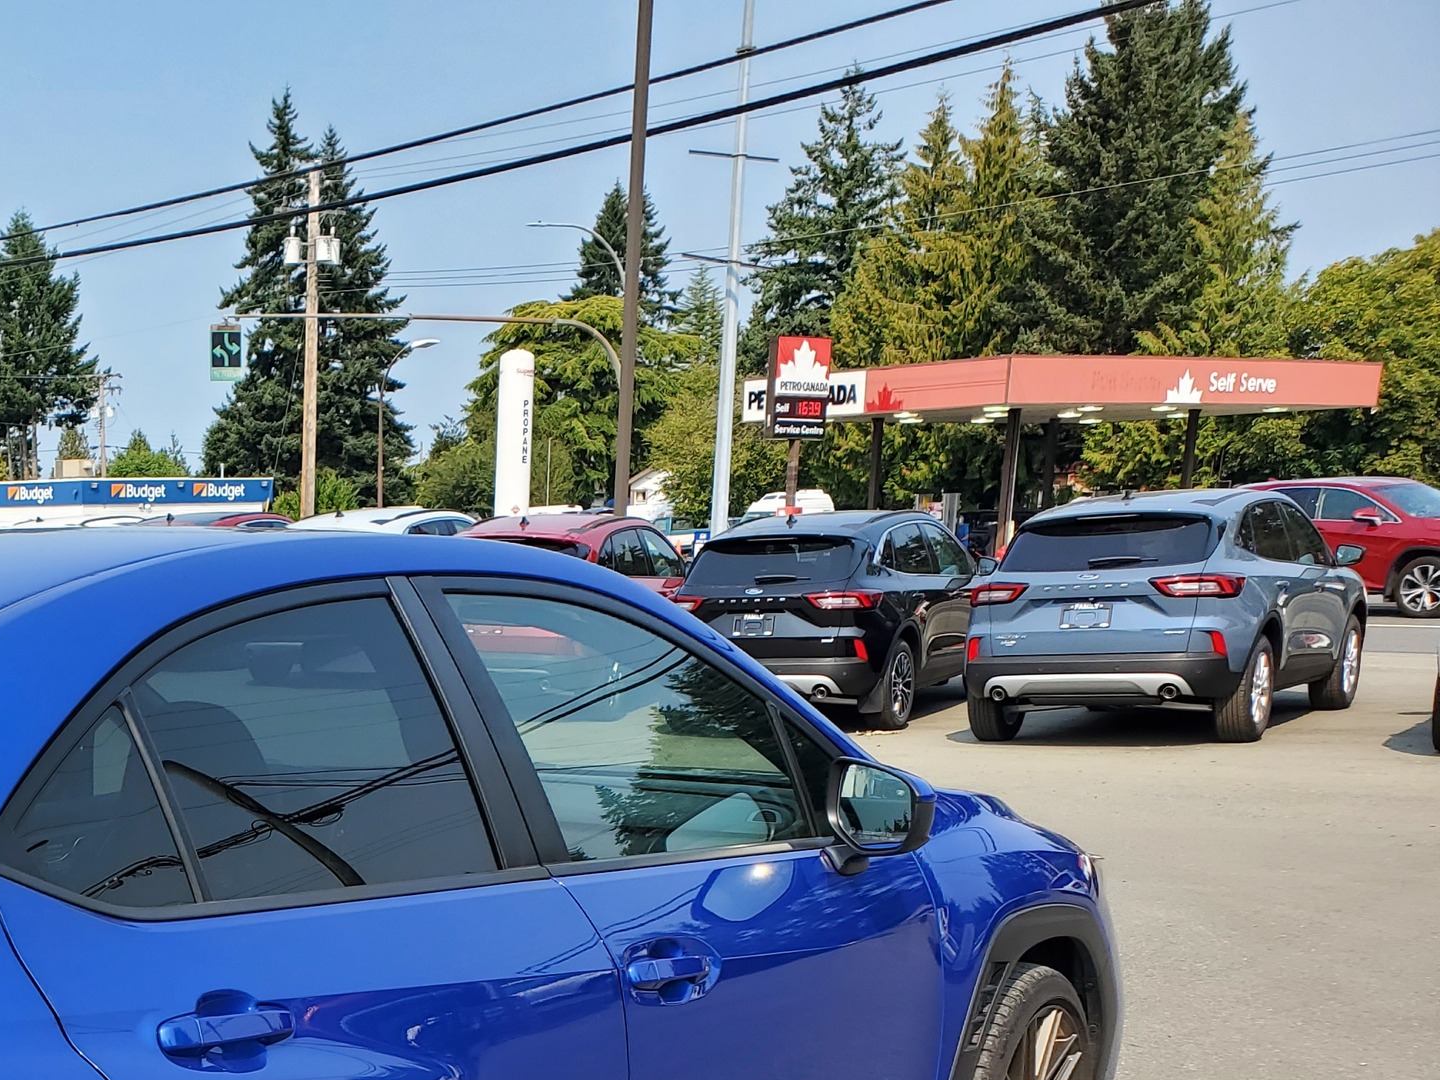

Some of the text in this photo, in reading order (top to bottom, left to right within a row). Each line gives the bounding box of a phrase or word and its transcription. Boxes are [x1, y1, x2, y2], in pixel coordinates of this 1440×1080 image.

[1209, 371, 1277, 394] Self Serve
[775, 402, 790, 413] Self
[522, 399, 530, 464] PROPANE
[774, 424, 824, 436] Service Centre
[19, 486, 54, 505] Budget
[126, 483, 166, 502] Budget
[206, 483, 245, 501] Budget
